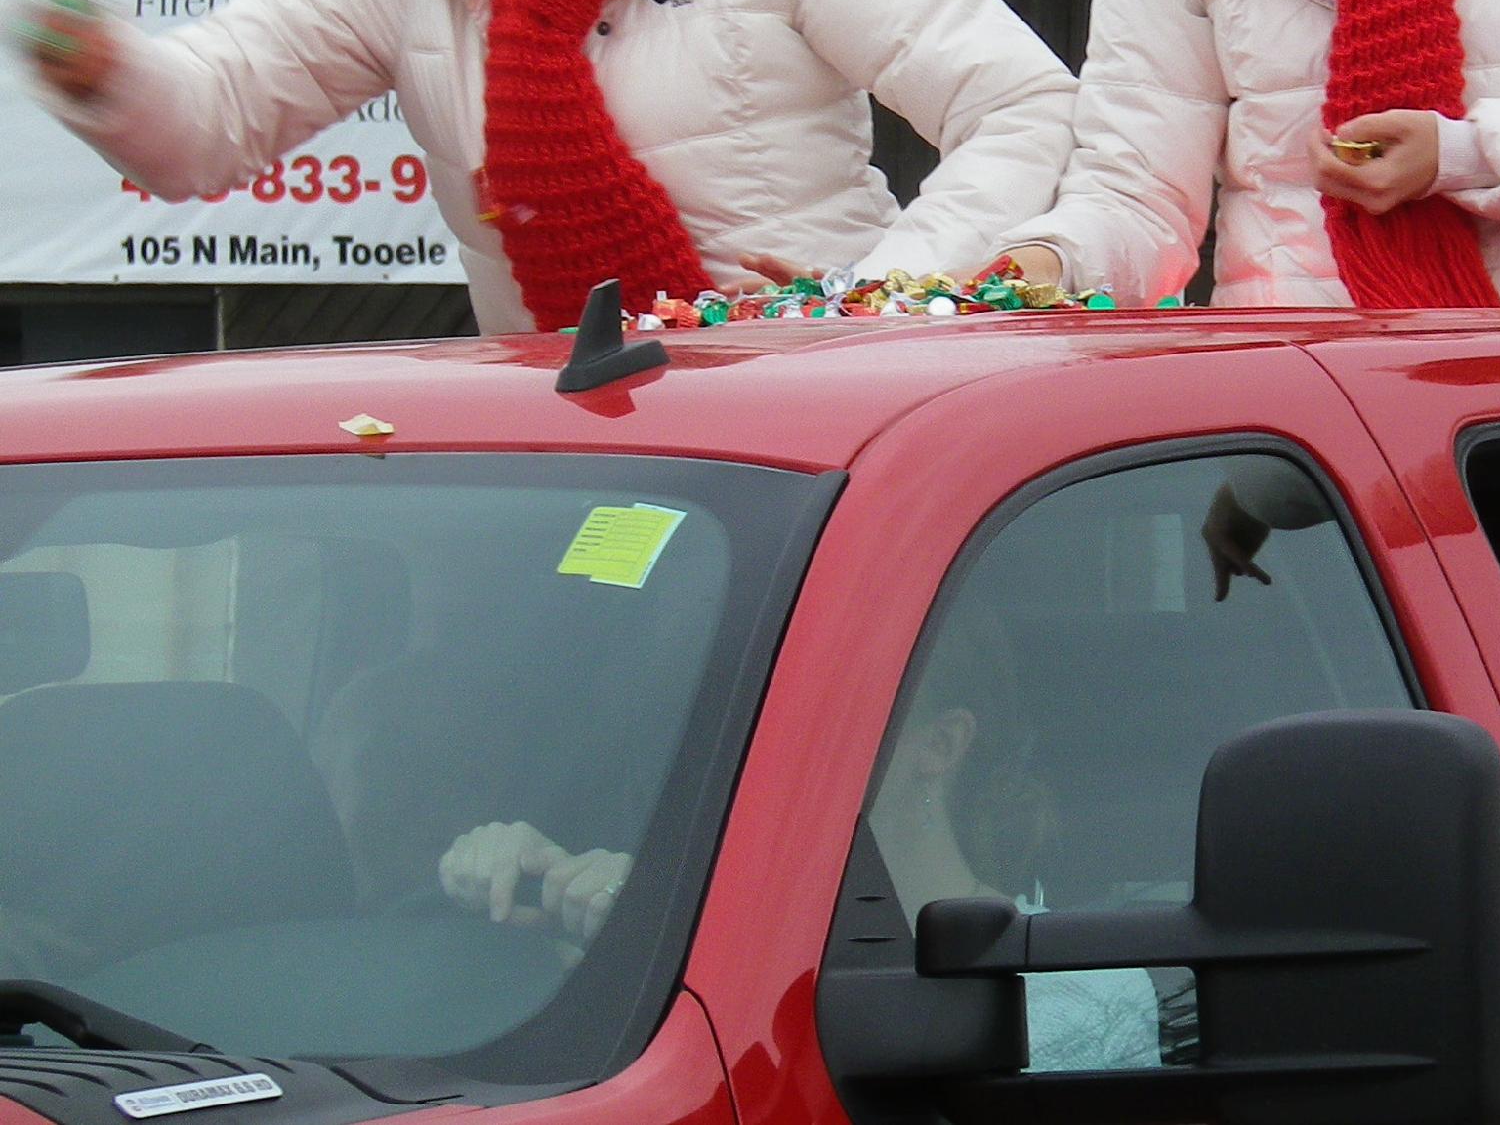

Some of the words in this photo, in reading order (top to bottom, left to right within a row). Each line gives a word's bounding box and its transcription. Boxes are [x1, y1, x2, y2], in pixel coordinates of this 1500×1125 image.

[121, 154, 428, 204] -833-9
[120, 235, 181, 266] 105
[192, 235, 217, 265] N
[228, 234, 321, 271] Main,
[332, 235, 447, 266] Tooele
